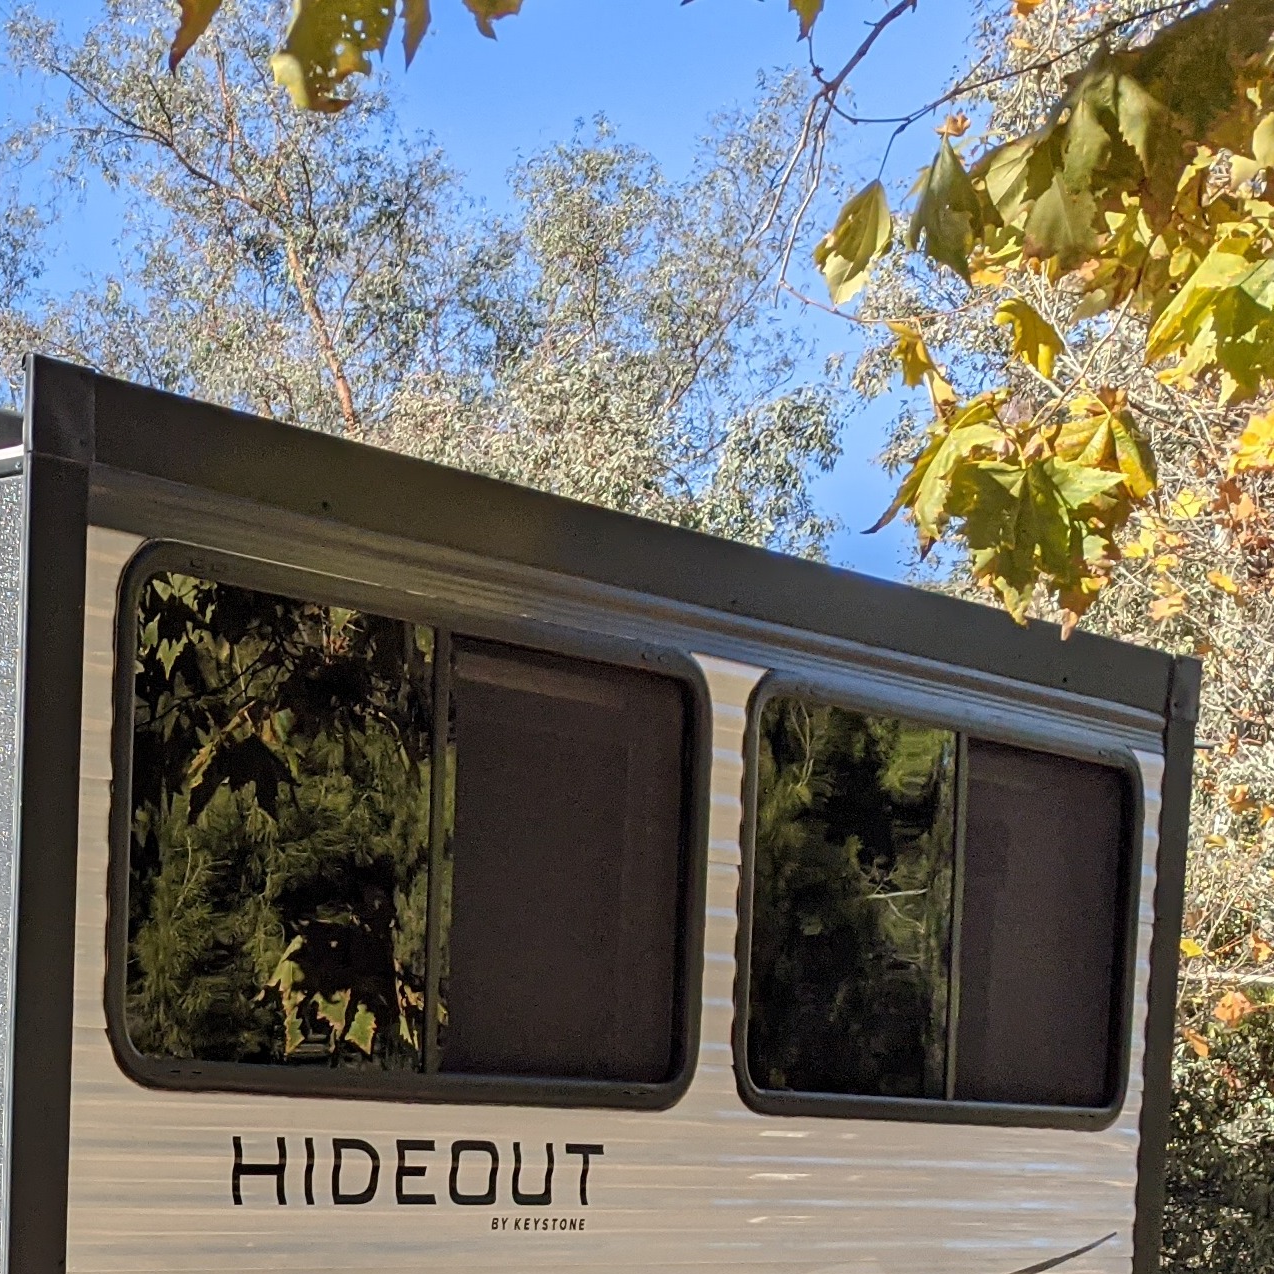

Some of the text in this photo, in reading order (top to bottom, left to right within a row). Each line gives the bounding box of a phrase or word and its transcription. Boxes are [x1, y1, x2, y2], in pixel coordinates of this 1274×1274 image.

[232, 1135, 605, 1206] HIDEOUT
[491, 1217, 586, 1232] BY KEYSTONE
